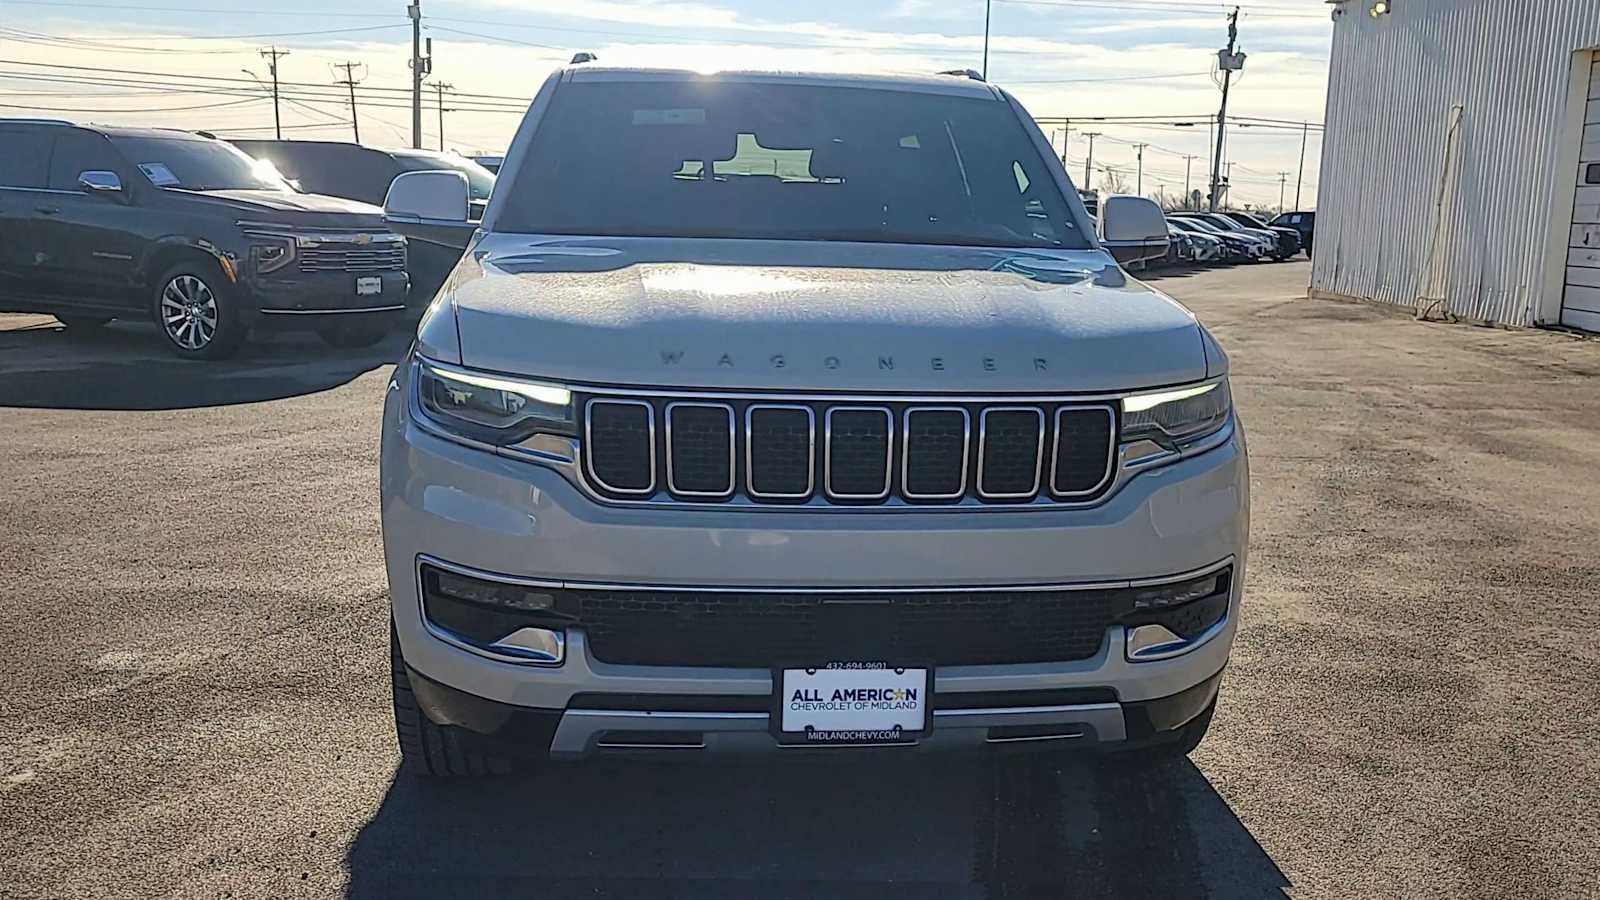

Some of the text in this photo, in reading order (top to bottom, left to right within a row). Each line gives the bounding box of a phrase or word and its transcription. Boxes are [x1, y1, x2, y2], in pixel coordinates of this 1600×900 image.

[660, 350, 1049, 371] WAGONEER
[791, 689, 823, 701] ALL
[790, 701, 917, 711] CHEVROLET OF MIDLAND
[807, 731, 900, 740] MIDLANDCHEVY.COM
